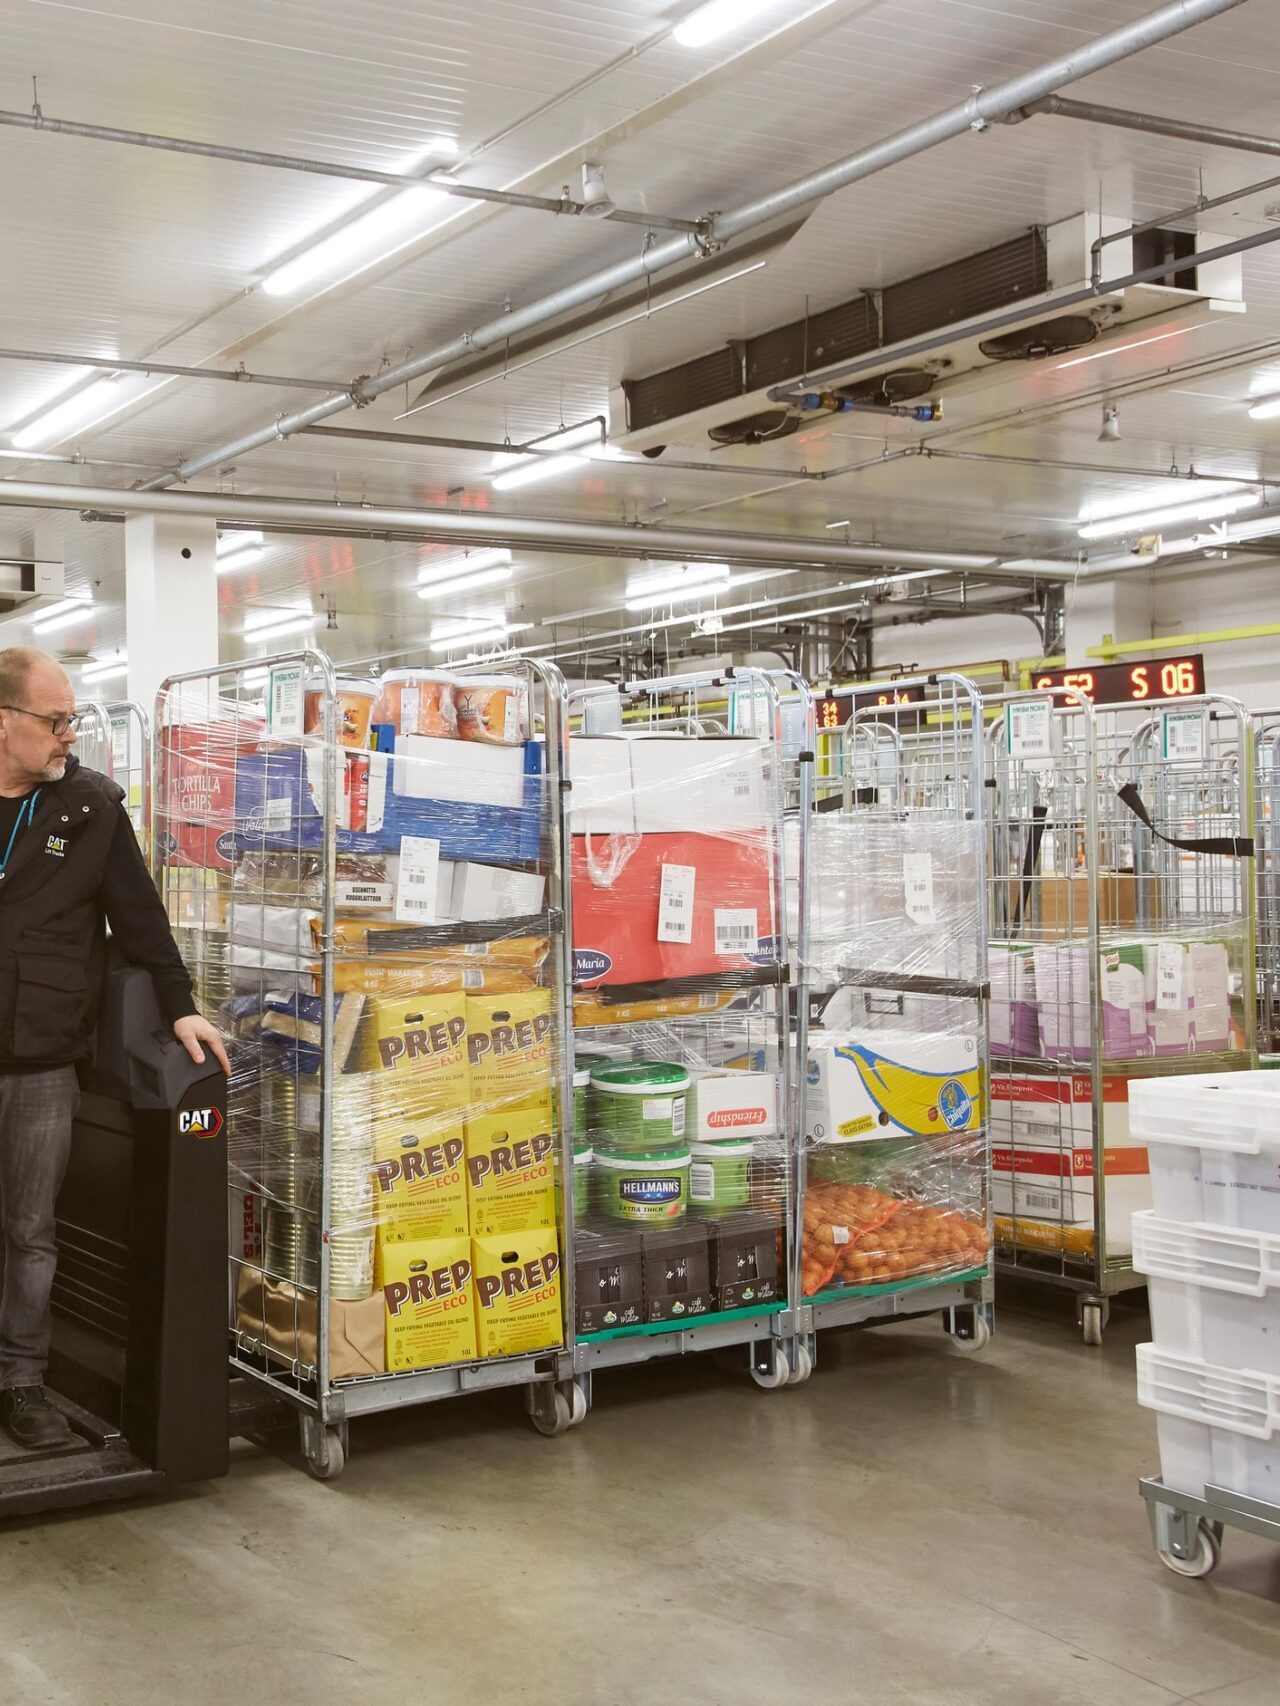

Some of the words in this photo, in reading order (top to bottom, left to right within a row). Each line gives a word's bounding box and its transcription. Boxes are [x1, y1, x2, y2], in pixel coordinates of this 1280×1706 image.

[1131, 667, 1149, 699] S
[1161, 662, 1195, 696] 06
[822, 702, 838, 715] 34
[824, 715, 838, 728] 63
[172, 775, 221, 794] TORTILLA
[182, 793, 212, 811] CHIPS
[47, 835, 66, 851] CAT
[576, 958, 605, 969] Maria
[377, 1016, 467, 1072] PREP
[467, 1013, 552, 1066] PREP
[440, 1054, 464, 1068] ECO
[525, 1047, 546, 1061] ECO
[180, 1109, 212, 1133] CAT
[710, 1109, 763, 1124] Friendship
[947, 1100, 971, 1126] Chiquita
[376, 1137, 465, 1194] PREP
[467, 1133, 553, 1188] PREP
[436, 1172, 460, 1189] ECO
[523, 1166, 548, 1182] ECO
[623, 1181, 679, 1194] HELLMANN'S
[416, 1198, 440, 1206] VEGETABLE
[384, 1259, 472, 1317] PREP
[476, 1252, 560, 1309] PREP
[534, 1286, 556, 1303] ECO
[443, 1295, 468, 1312] ECO
[424, 1321, 446, 1329] VEGETABLE
[517, 1313, 539, 1321] VEGETABLE
